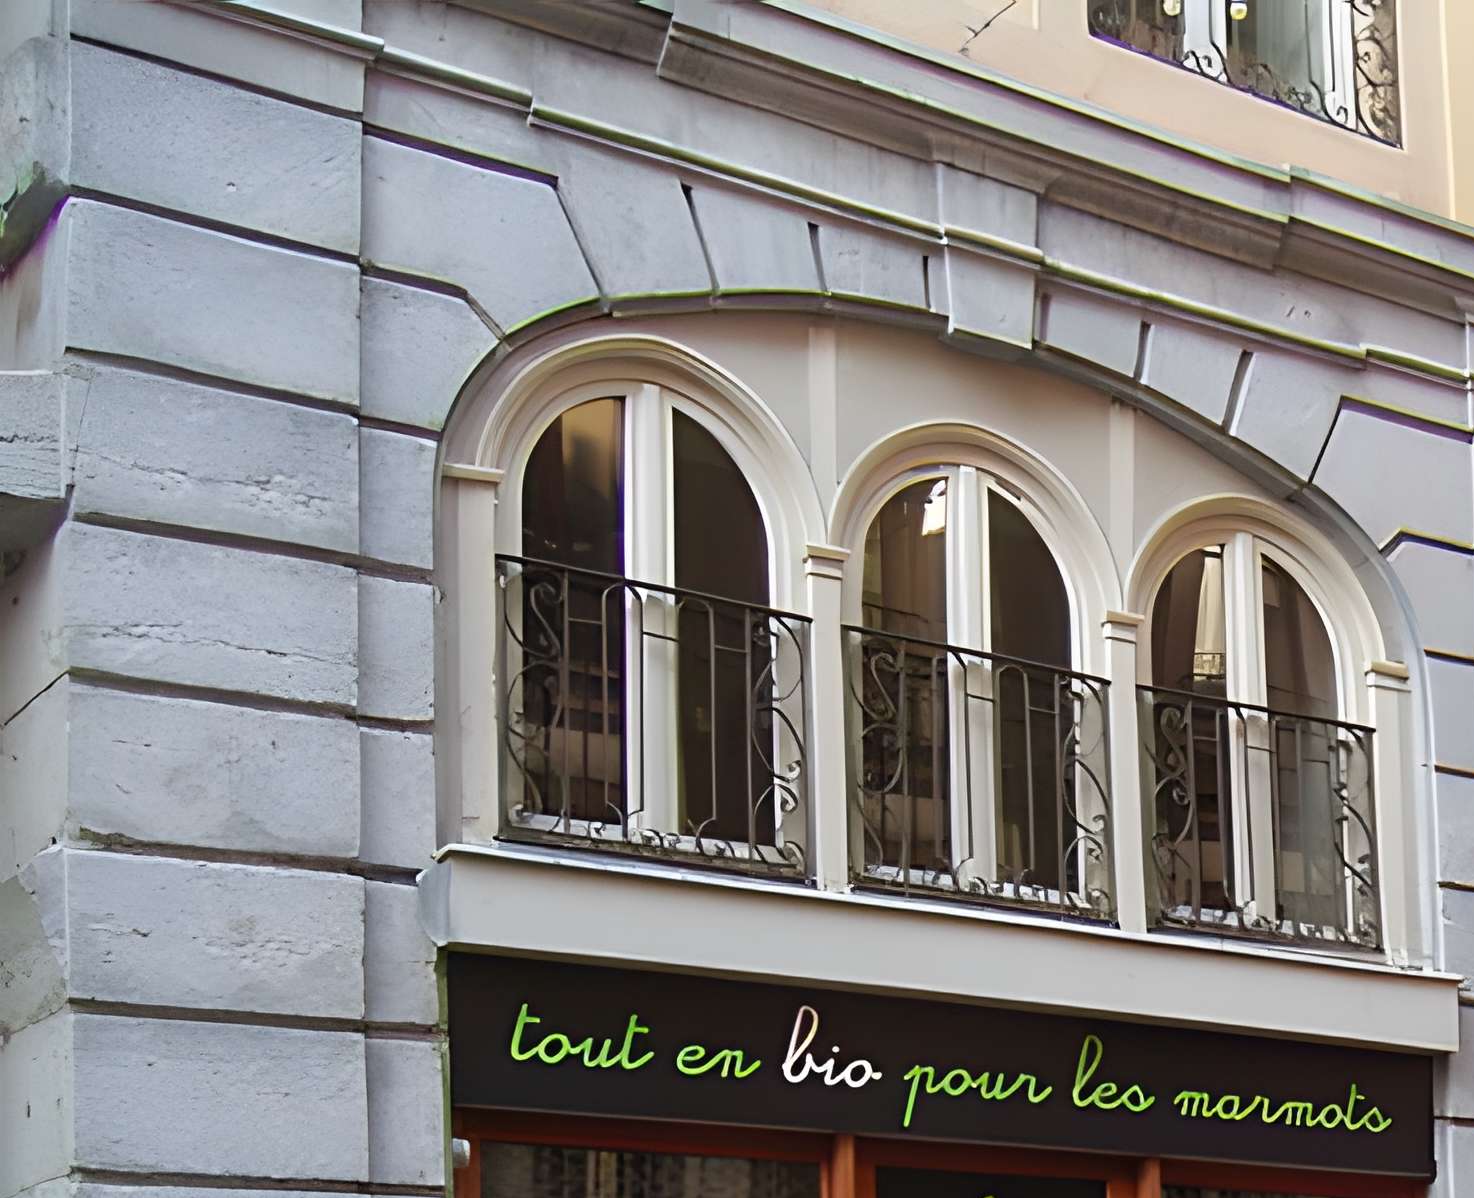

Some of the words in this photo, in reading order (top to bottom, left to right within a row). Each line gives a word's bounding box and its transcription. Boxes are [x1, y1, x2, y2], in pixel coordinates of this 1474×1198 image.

[510, 1003, 654, 1070] tout
[676, 1045, 761, 1078] en
[782, 1005, 882, 1088] bio
[903, 1065, 1052, 1127] pour
[1072, 1034, 1155, 1112] les
[1174, 1084, 1392, 1132] marmots
